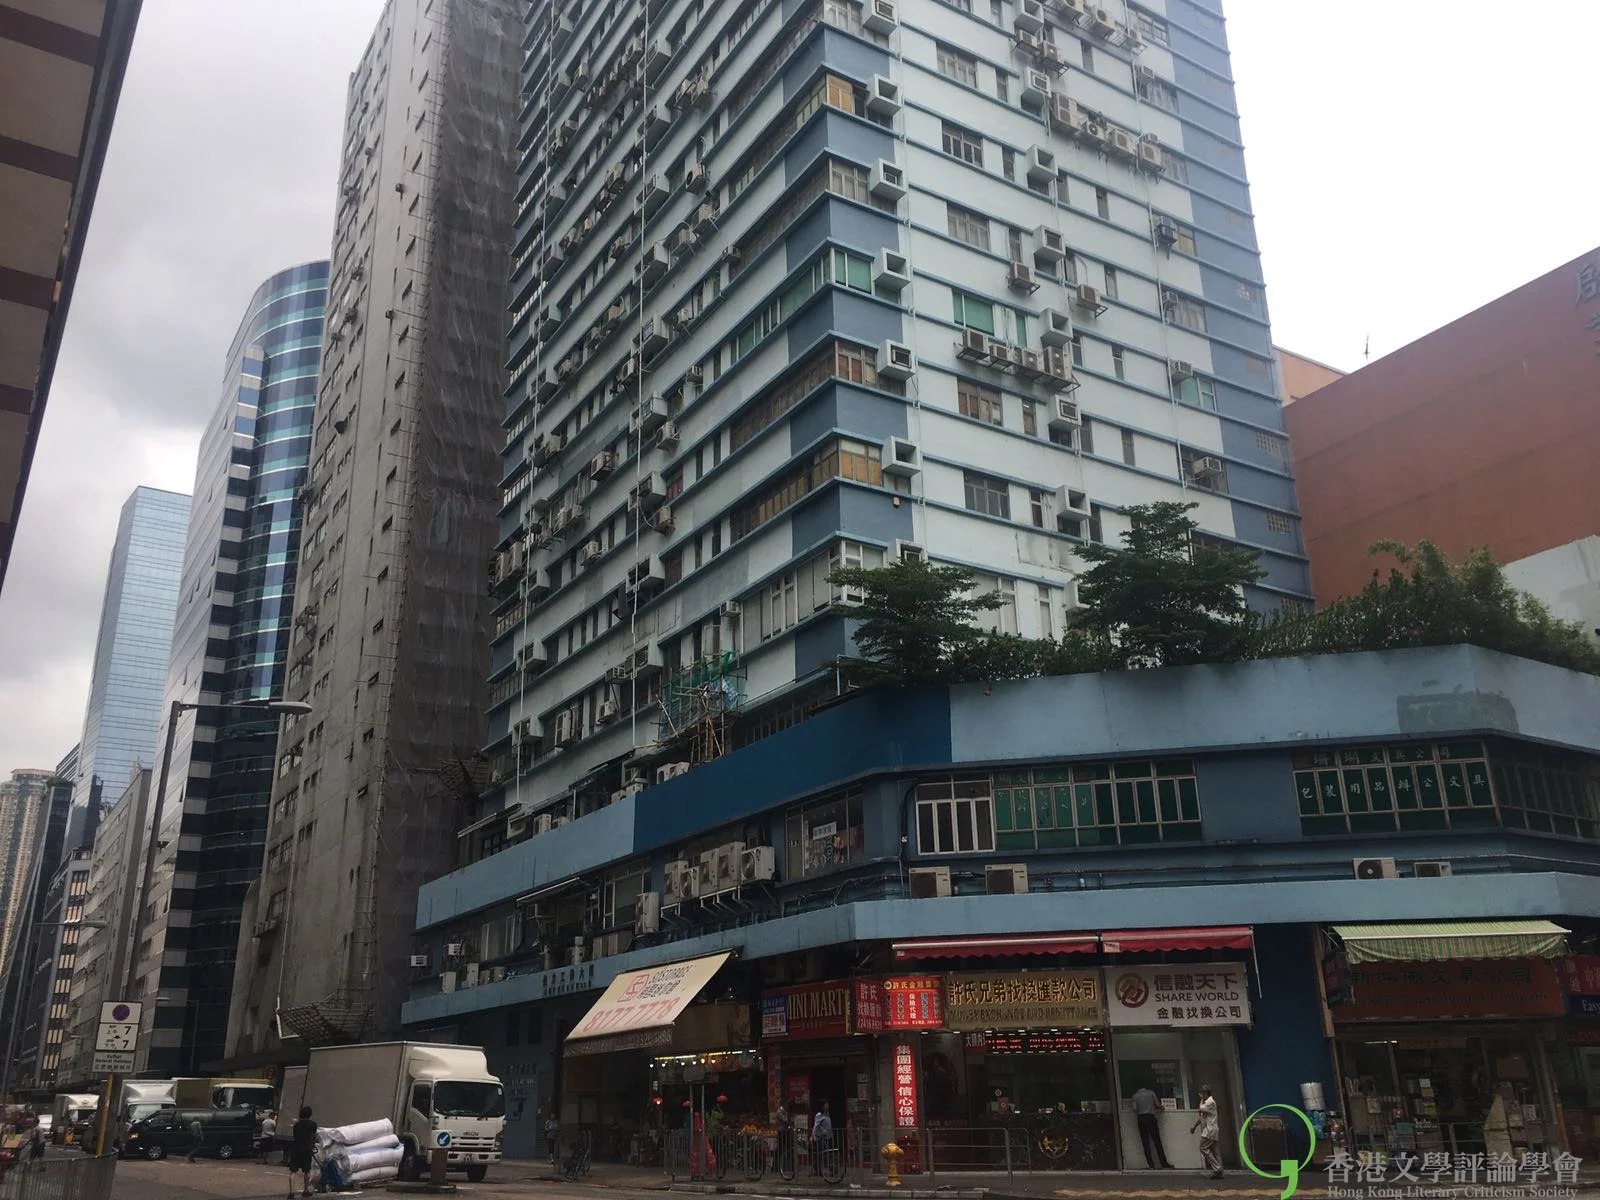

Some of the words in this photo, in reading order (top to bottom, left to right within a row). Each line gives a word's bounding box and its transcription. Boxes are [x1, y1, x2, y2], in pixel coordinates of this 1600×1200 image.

[1153, 972, 1238, 991] 信融天下
[860, 983, 878, 1001] 許氏
[1155, 992, 1193, 1002] SHARE
[1195, 991, 1239, 1002] WORLD
[810, 988, 844, 1018] MART
[1157, 1005, 1242, 1019] 金融找換公司
[125, 1026, 131, 1034] 7
[122, 1040, 129, 1048] 7
